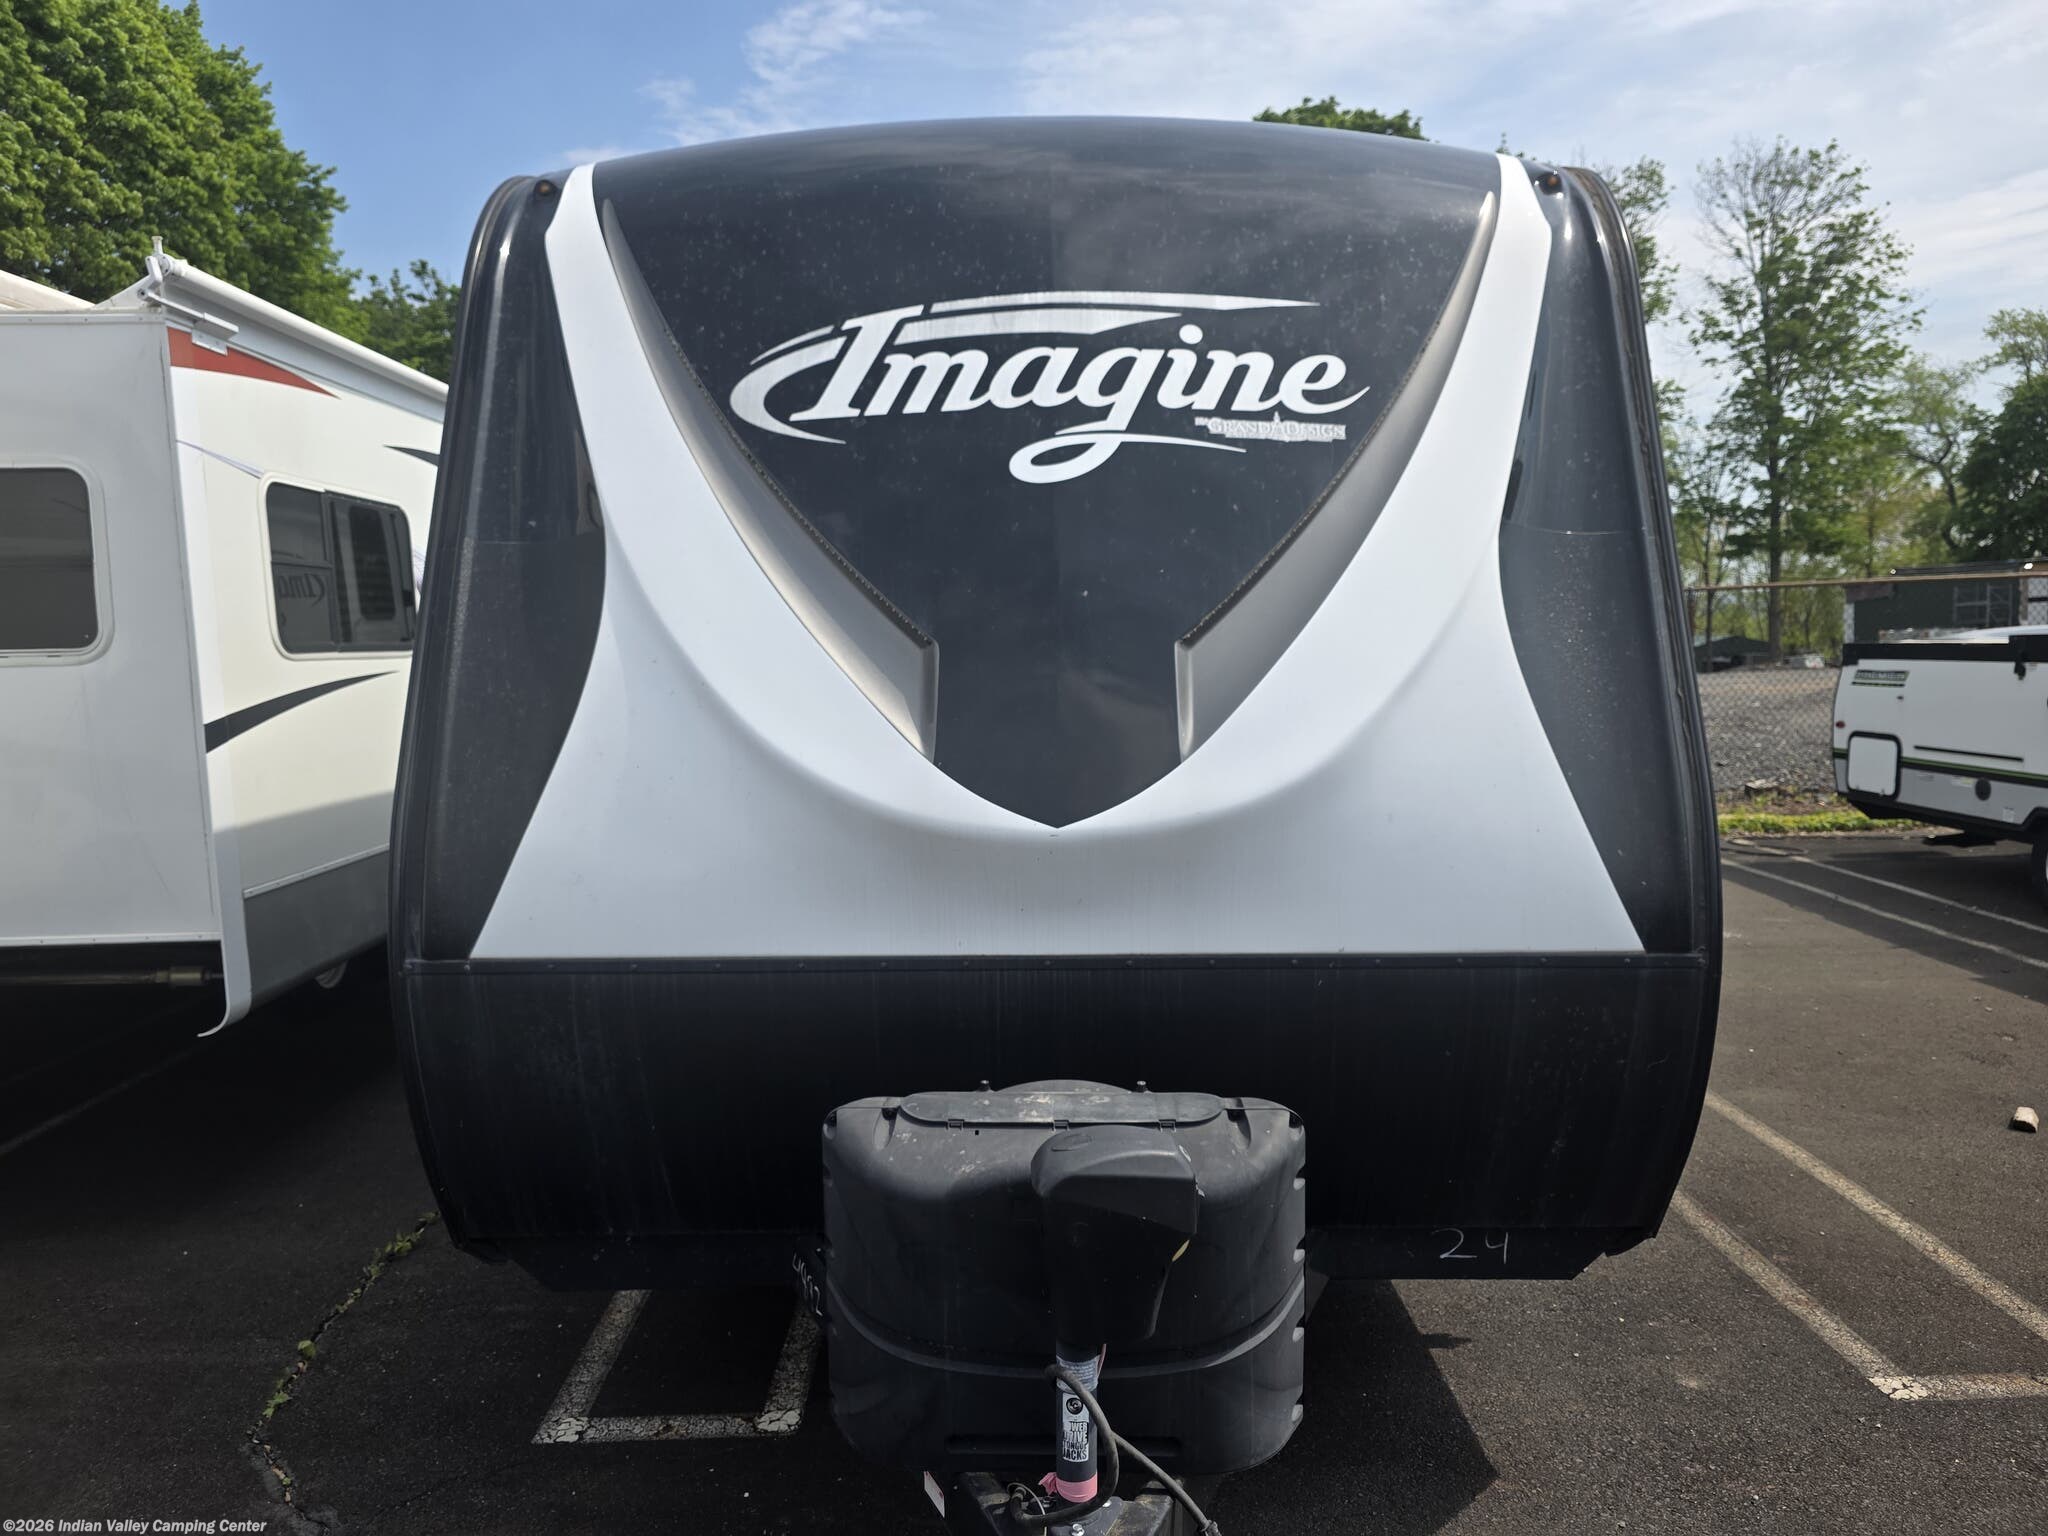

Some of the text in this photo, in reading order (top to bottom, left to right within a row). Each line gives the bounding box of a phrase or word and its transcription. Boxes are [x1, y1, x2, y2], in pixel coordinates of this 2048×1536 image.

[732, 305, 1371, 484] Imagine
[1430, 1227, 1509, 1264] 24
[1062, 1448, 1087, 1460] JACKS
